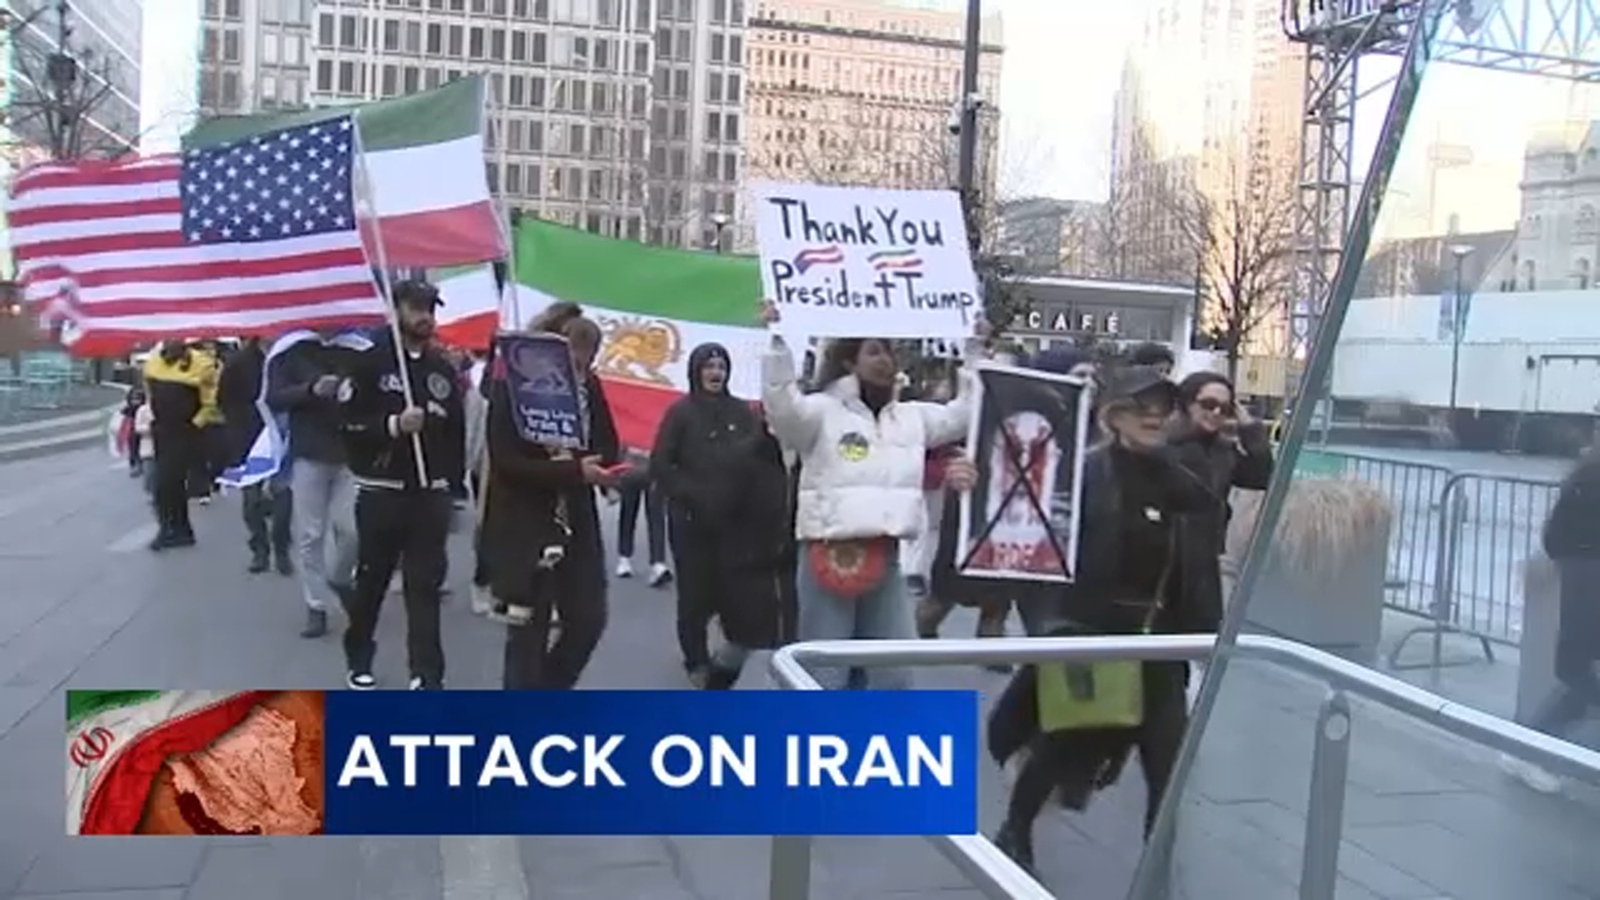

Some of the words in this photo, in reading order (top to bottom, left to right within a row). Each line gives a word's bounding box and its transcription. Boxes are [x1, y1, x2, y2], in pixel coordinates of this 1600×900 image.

[766, 197, 877, 245] Thank
[876, 207, 944, 247] You
[771, 259, 897, 308] President
[892, 271, 975, 327] Trump
[1028, 311, 1119, 333] CAFÉ
